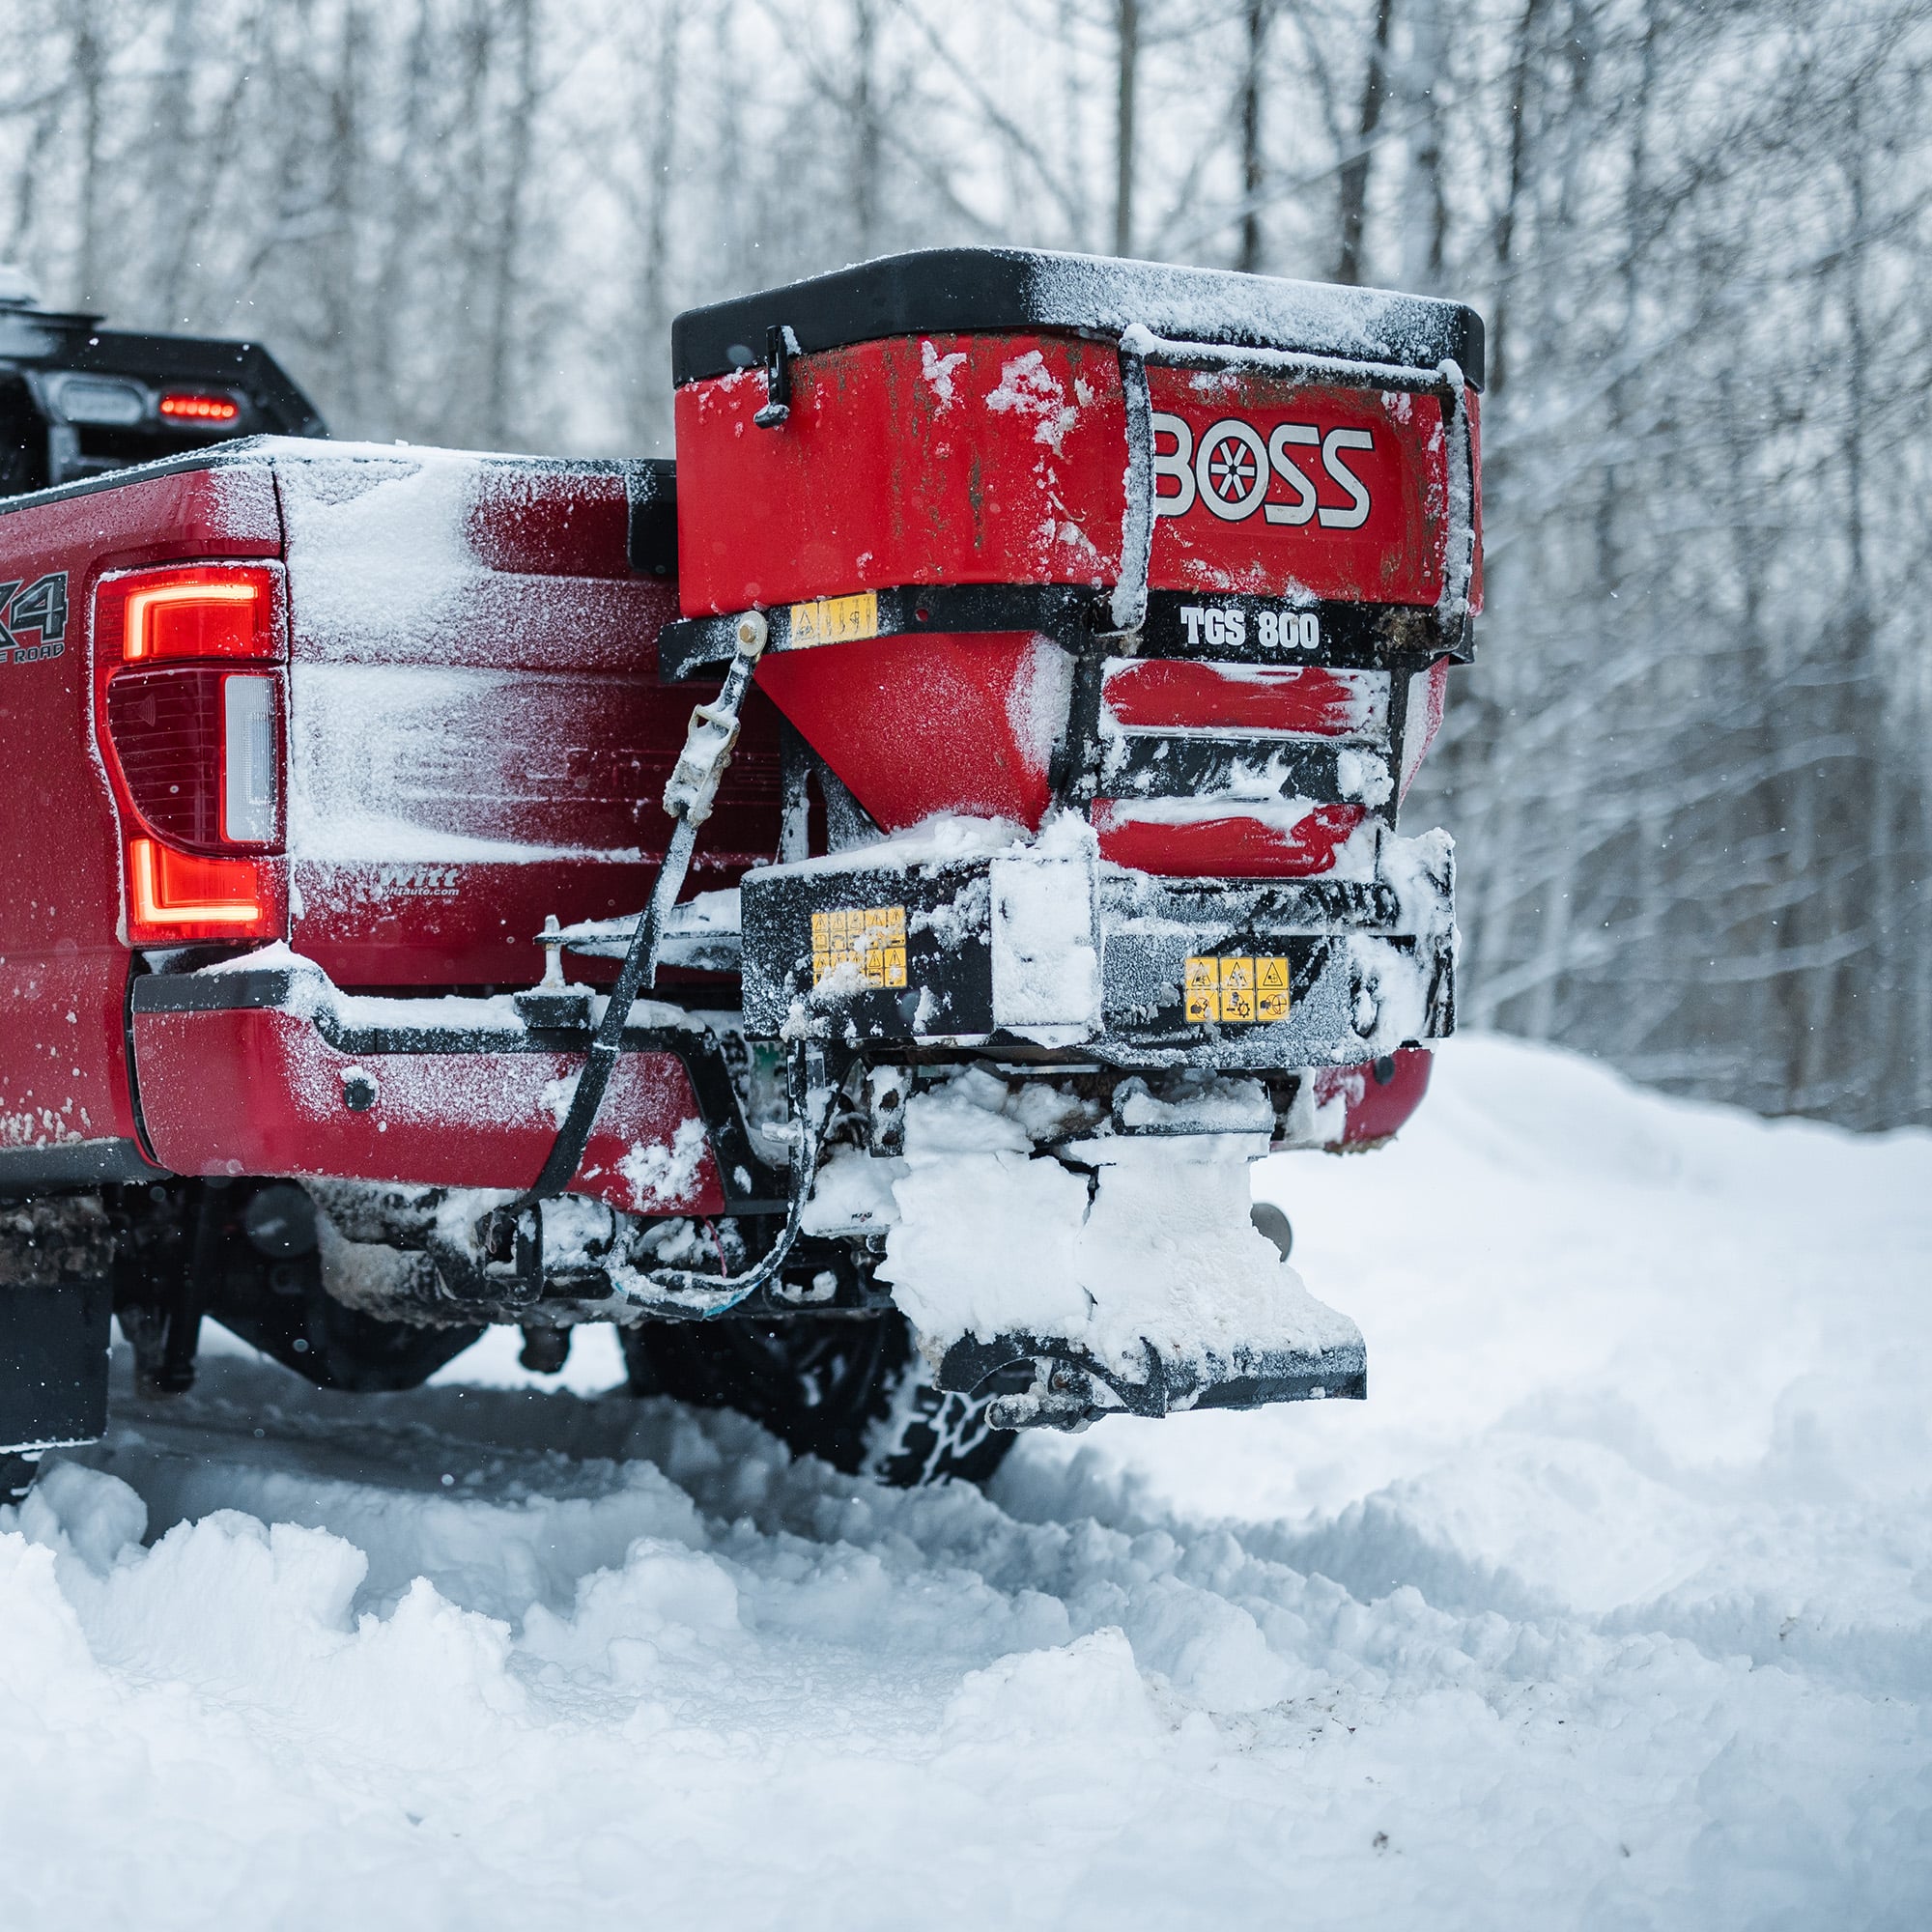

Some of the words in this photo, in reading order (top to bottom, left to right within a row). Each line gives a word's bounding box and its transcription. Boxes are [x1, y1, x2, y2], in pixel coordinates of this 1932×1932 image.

[1152, 412, 1374, 528] BOSS
[1180, 606, 1246, 646] TGS
[1258, 611, 1320, 649] 800
[14, 642, 65, 664] ROAD
[379, 867, 459, 887] Witt
